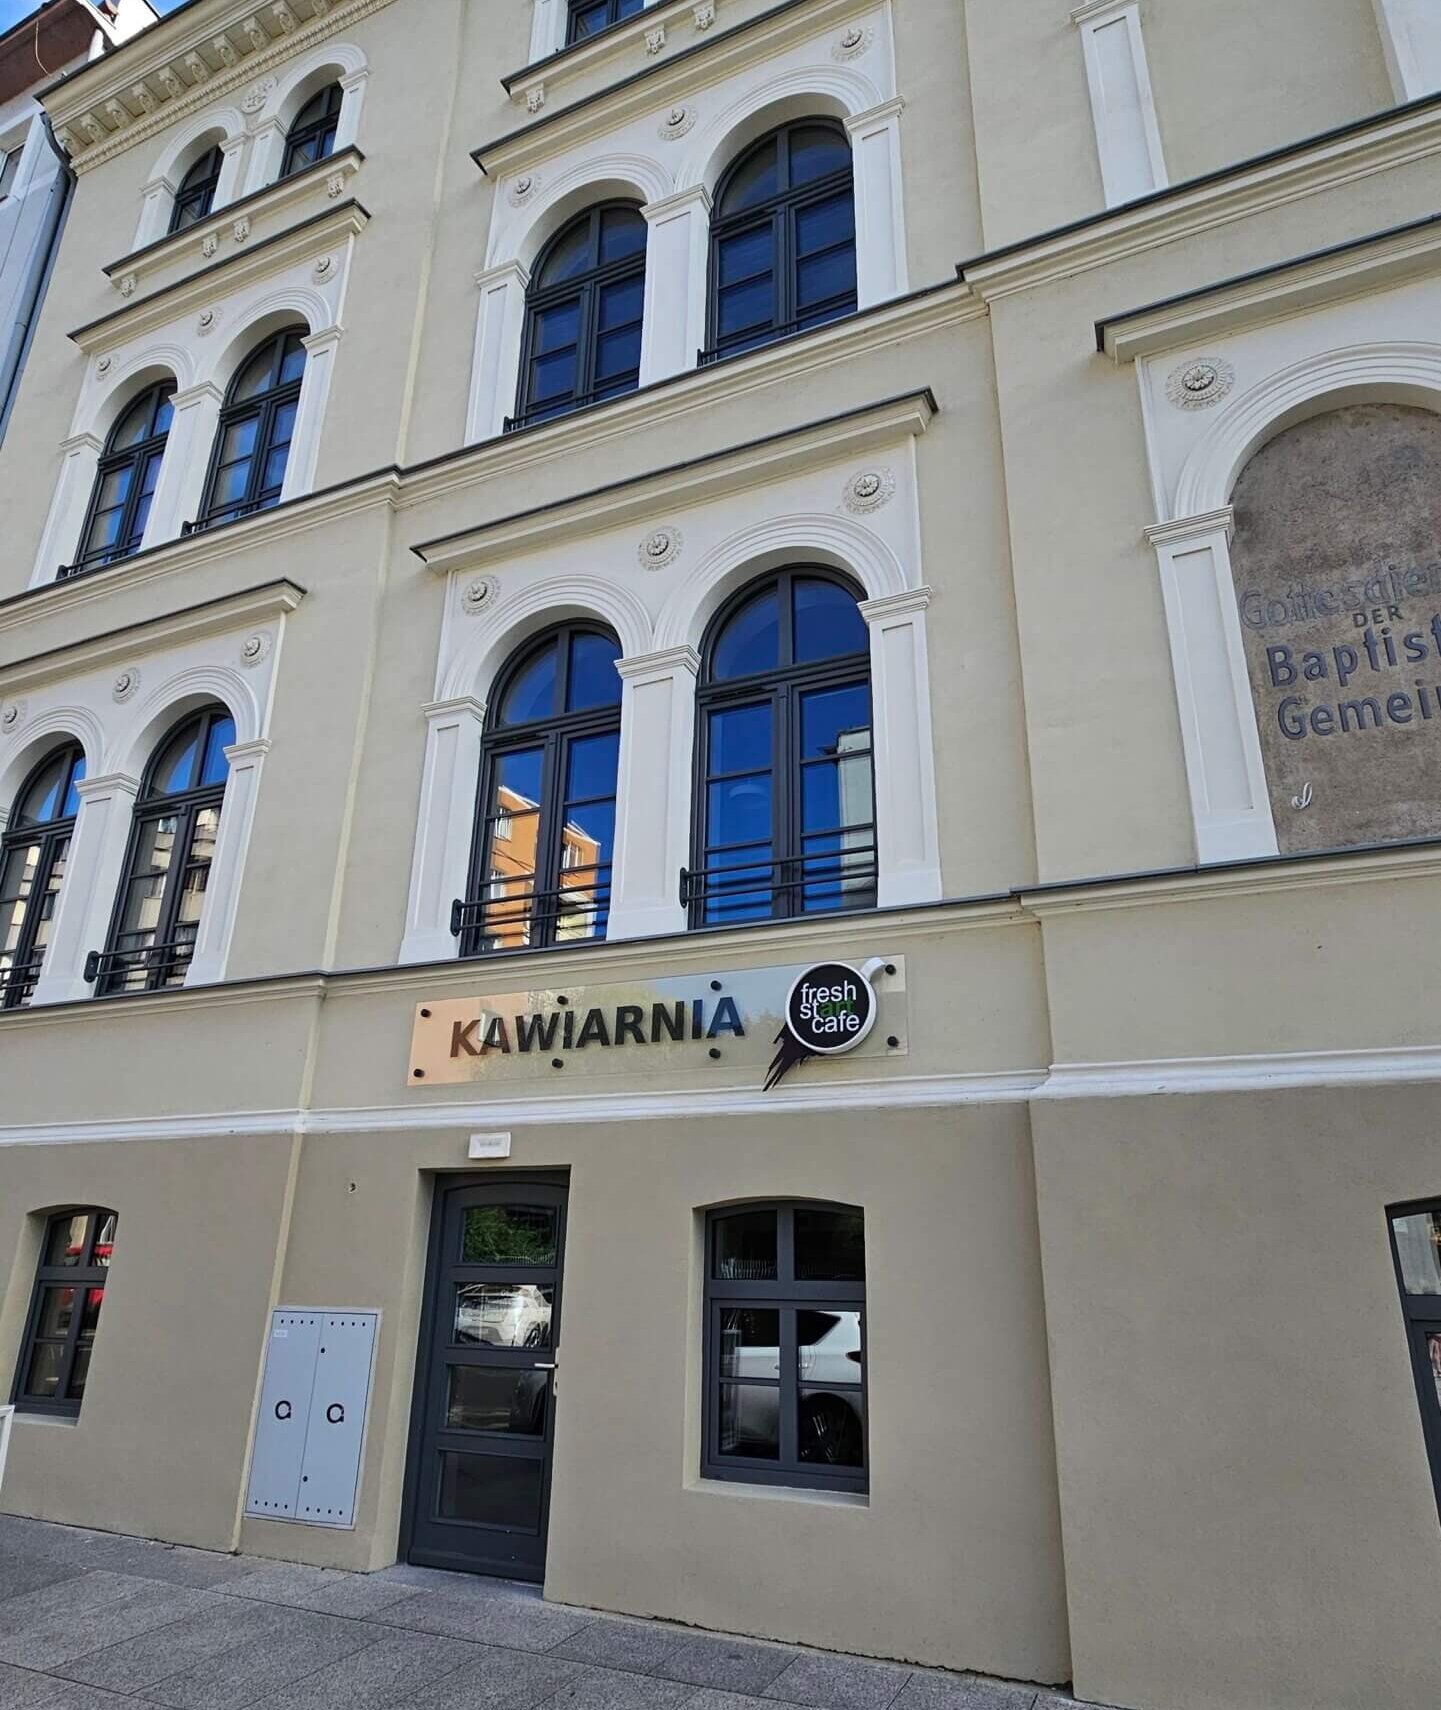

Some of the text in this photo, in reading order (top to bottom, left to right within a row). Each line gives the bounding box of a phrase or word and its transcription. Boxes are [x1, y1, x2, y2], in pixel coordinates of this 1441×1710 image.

[1353, 605, 1404, 628] DER
[1277, 678, 1441, 740] Gemei
[800, 980, 857, 1003] fresh
[799, 997, 855, 1019] start
[449, 996, 746, 1058] KAWIARNIA
[811, 1010, 861, 1034] cafe
